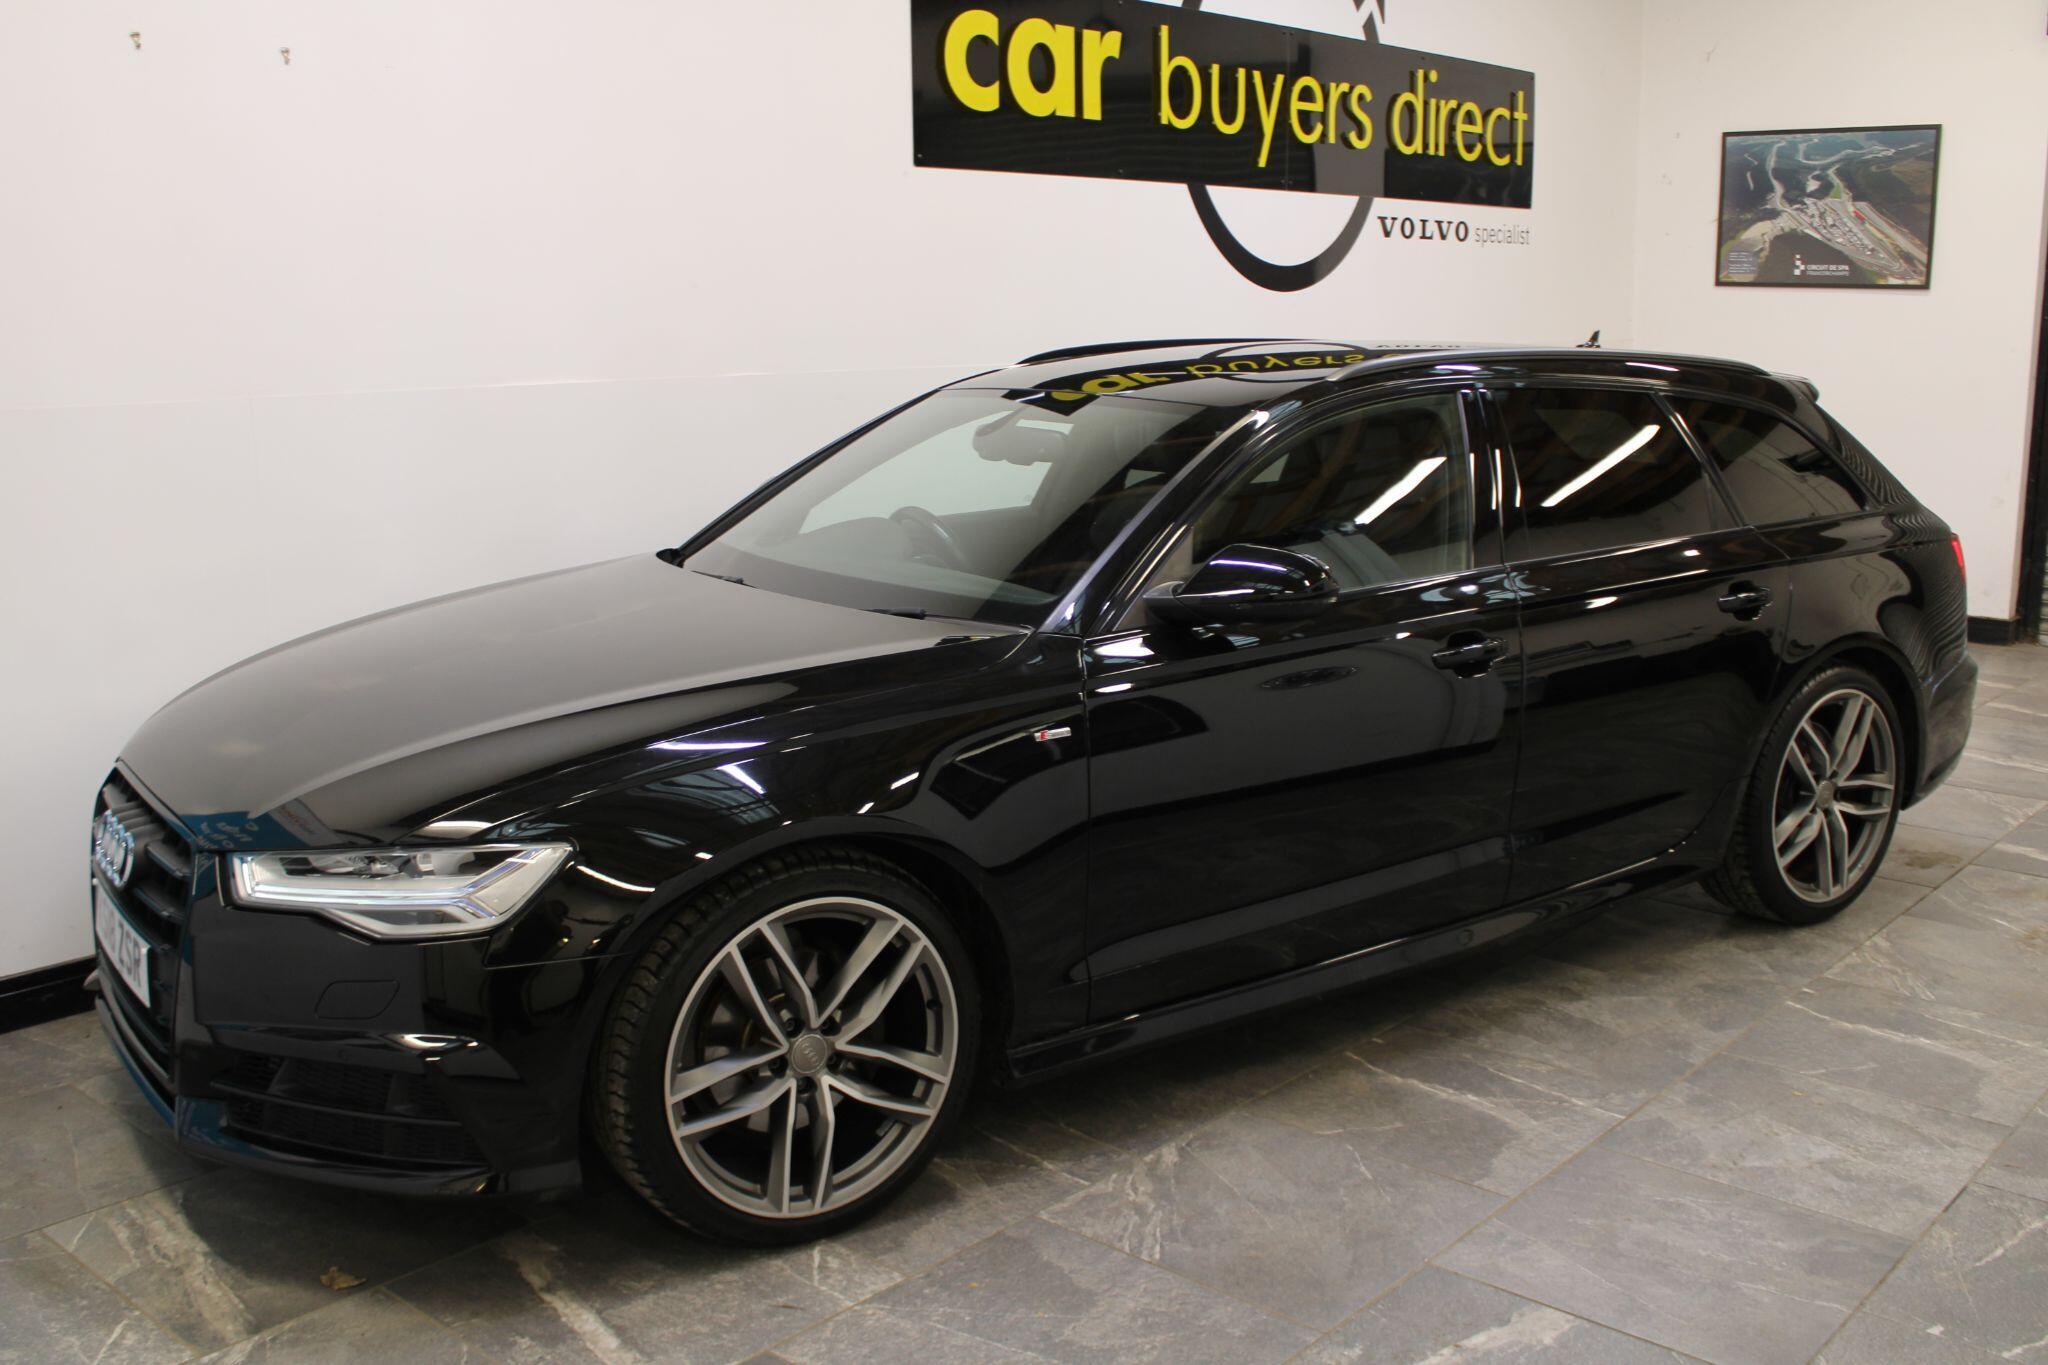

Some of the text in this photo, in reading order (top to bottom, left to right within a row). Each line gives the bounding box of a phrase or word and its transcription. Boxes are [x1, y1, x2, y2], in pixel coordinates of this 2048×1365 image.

[944, 9, 1529, 168] car buyers direct
[1376, 215, 1531, 248] VOLVO specialist
